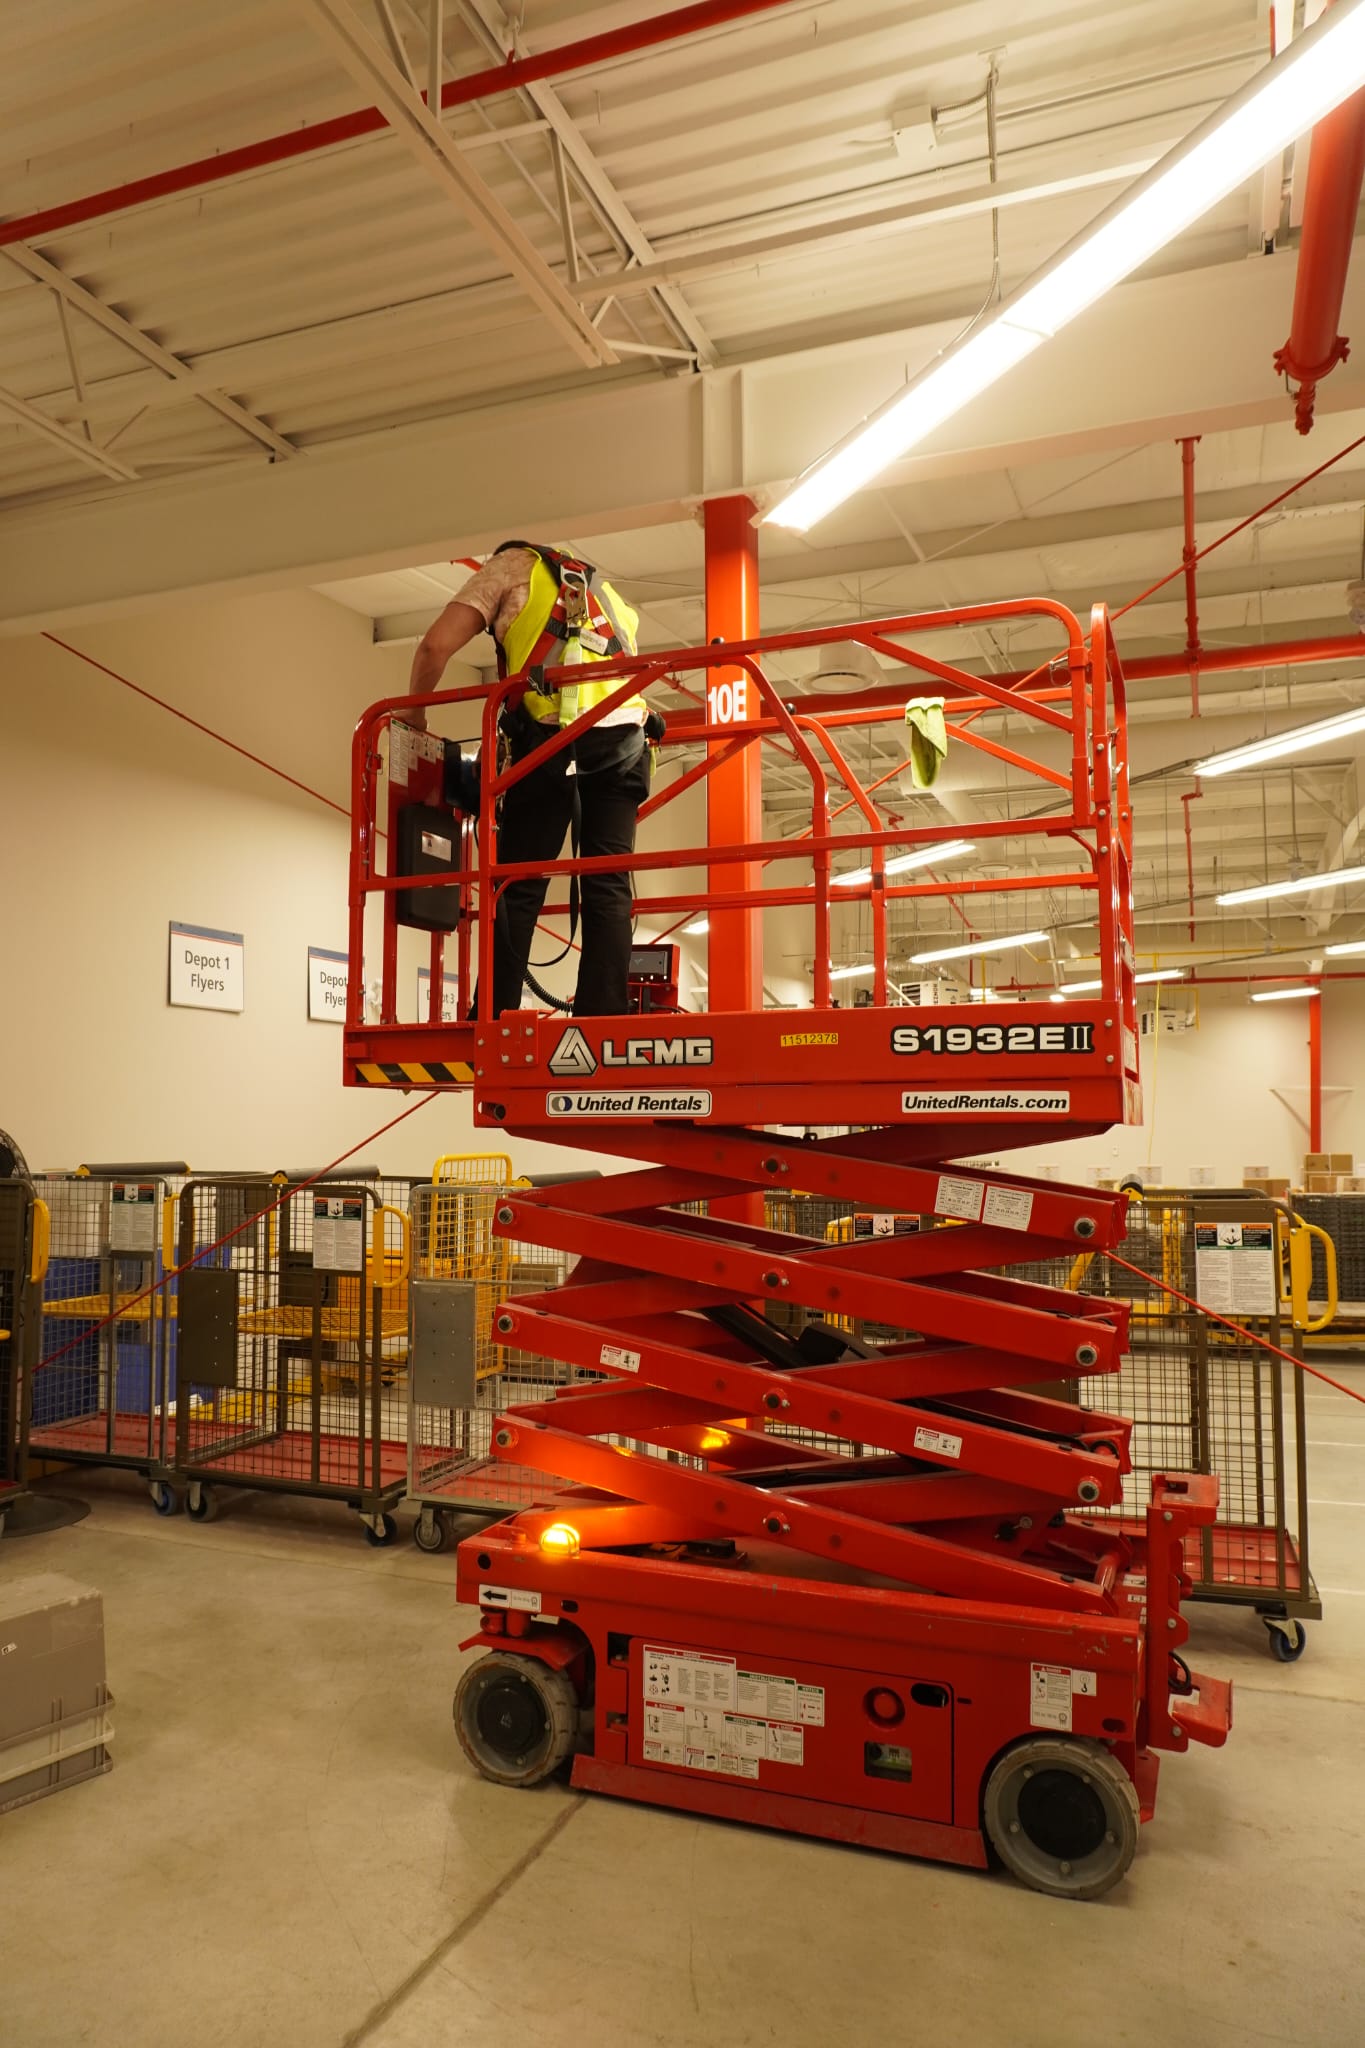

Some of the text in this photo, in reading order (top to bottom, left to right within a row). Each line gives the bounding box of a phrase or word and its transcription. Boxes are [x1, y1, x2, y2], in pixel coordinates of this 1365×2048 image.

[708, 680, 747, 725] 10E
[185, 950, 230, 970] Depot 1
[191, 973, 225, 992] Flyers
[320, 971, 347, 988] Depot
[325, 991, 346, 1008] Flyer
[450, 993, 455, 1004] 3
[783, 1034, 838, 1046] 11512378
[603, 1038, 713, 1066] LGMG
[576, 1096, 702, 1112] United Rentals
[904, 1095, 1068, 1110] UnitedRentals.com
